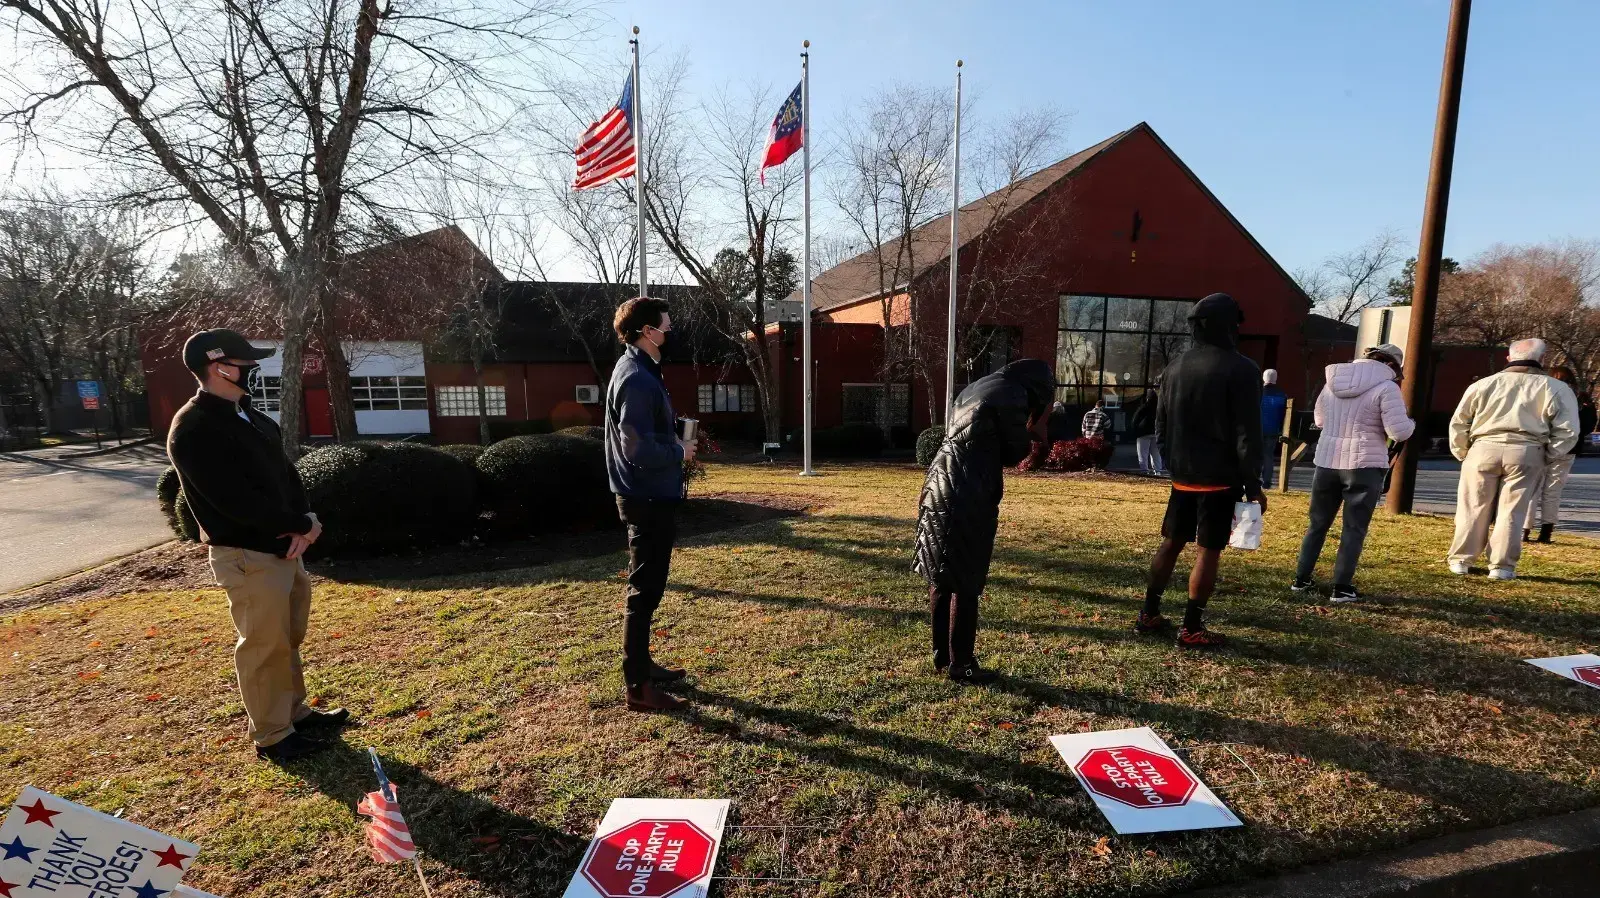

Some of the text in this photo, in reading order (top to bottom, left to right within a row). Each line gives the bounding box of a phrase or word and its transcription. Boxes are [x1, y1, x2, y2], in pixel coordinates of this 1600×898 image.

[1119, 320, 1138, 329] 4400
[1101, 763, 1132, 789] STOP
[1107, 750, 1164, 804] ONE-PARTY
[1135, 760, 1169, 786] RULE
[27, 828, 88, 892] THANK
[64, 851, 107, 888] YOU
[616, 838, 642, 871] STOP
[628, 822, 670, 895] ONE-PARTY
[658, 839, 685, 872] RULE
